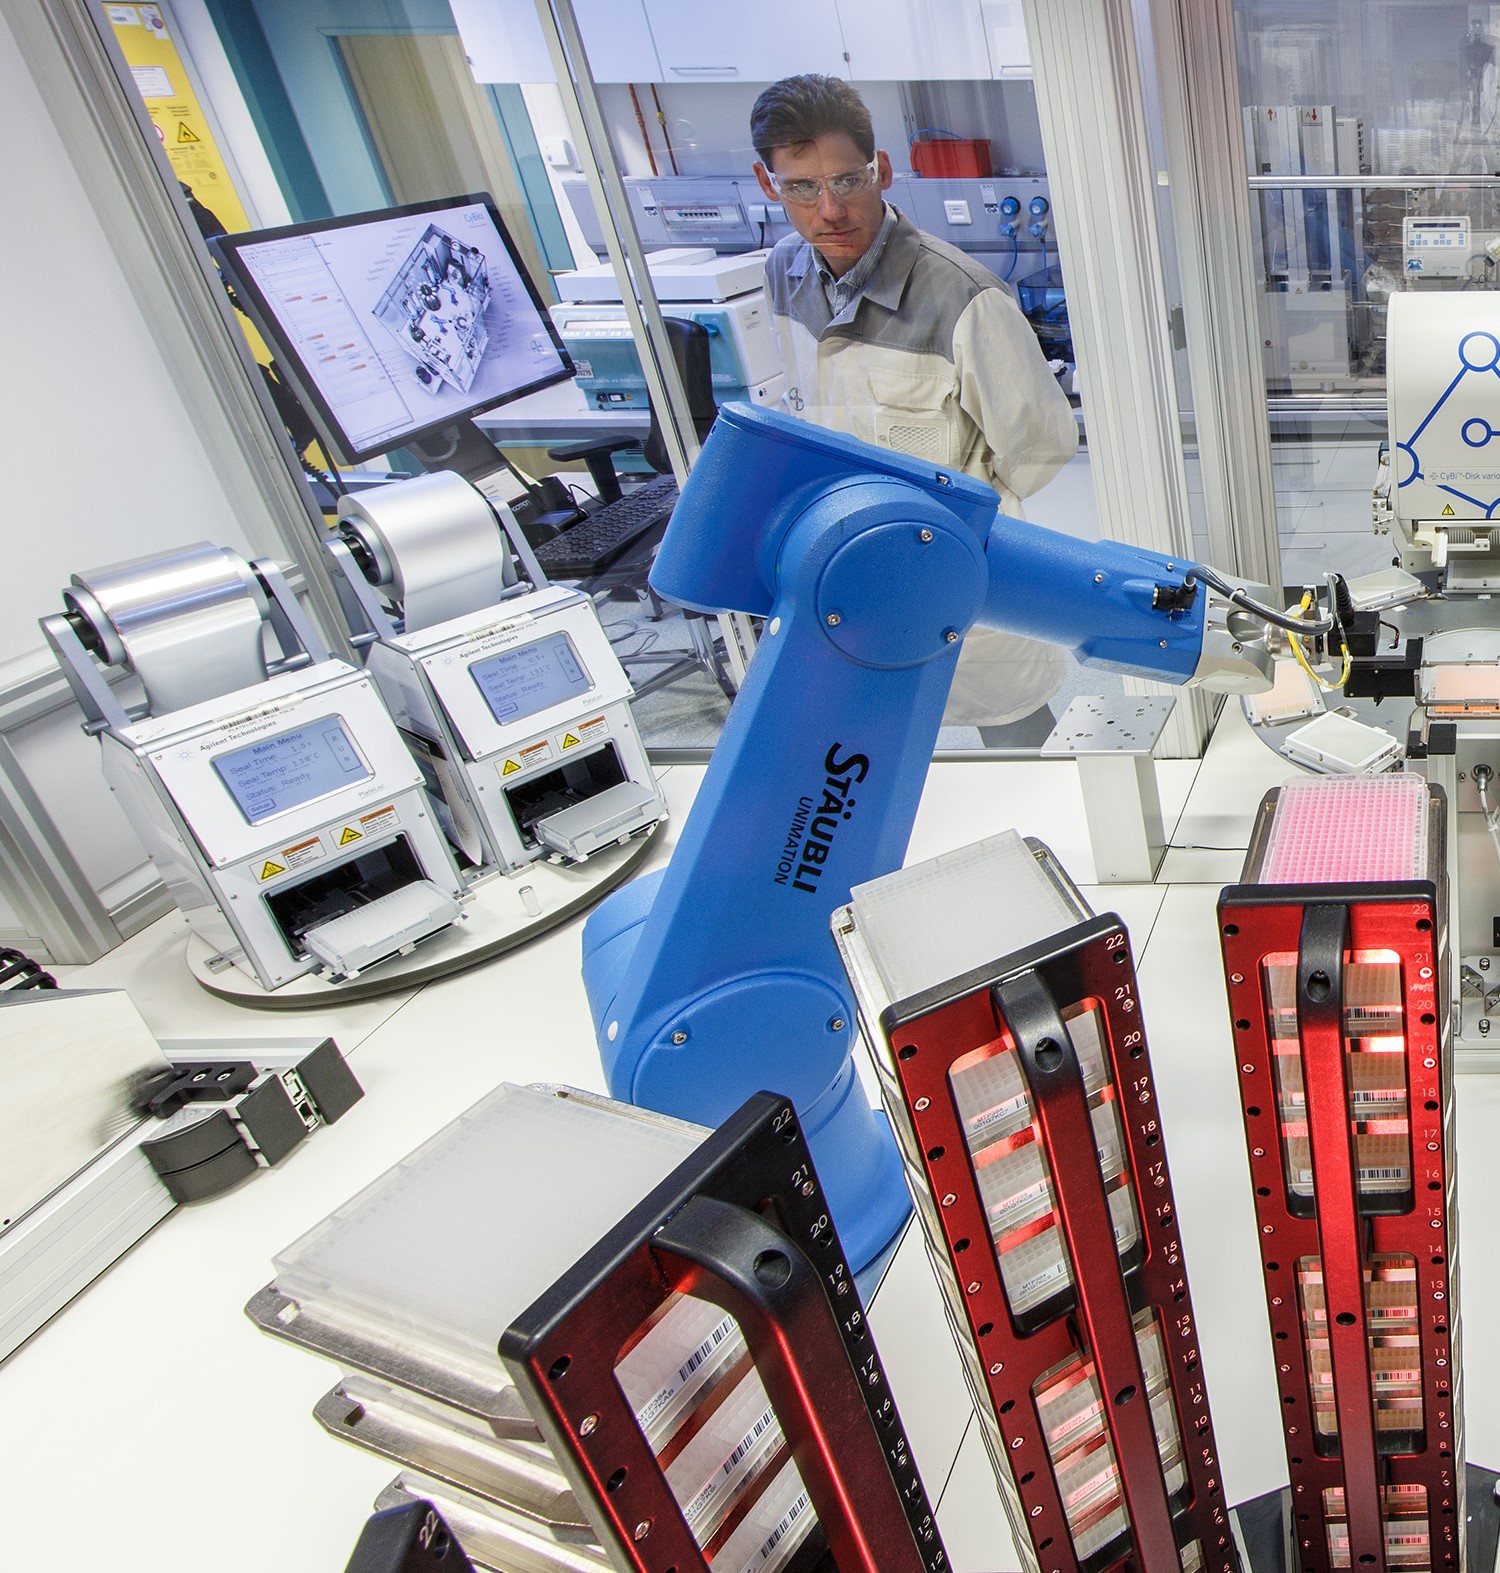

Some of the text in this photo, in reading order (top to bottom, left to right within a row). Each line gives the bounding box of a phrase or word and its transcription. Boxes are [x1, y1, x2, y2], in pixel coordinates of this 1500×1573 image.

[460, 635, 518, 659] Agilent Technologies
[499, 647, 538, 664] Main Menu
[482, 671, 499, 681] Seal
[488, 682, 505, 692] Seal
[522, 681, 544, 693] Ready
[200, 721, 278, 752] Agilent Technologies
[253, 733, 303, 755] Main Menu
[230, 762, 252, 775] Seal
[238, 775, 260, 788] Seal
[281, 772, 311, 787] Ready
[358, 784, 384, 797] PlateLoc
[251, 802, 271, 813] Setup
[792, 741, 870, 894] STÄUBLI
[774, 796, 814, 886] UNIMATION
[1412, 904, 1430, 915] 22
[1106, 934, 1125, 950] 22
[1414, 952, 1430, 963] 21
[1114, 983, 1131, 1000] 21
[1416, 1000, 1433, 1010] 20
[1123, 1031, 1141, 1047] 20
[1420, 1044, 1435, 1055] 19
[1133, 1076, 1148, 1091] 19
[1421, 1087, 1436, 1098] 18
[772, 1108, 792, 1133] 22
[1141, 1121, 1157, 1135] 18
[1423, 1129, 1438, 1138] 17
[1148, 1161, 1163, 1177] 17
[1425, 1169, 1440, 1178] 16
[791, 1164, 809, 1188] 21
[1155, 1203, 1171, 1217] 16
[1427, 1207, 1441, 1217] 15
[810, 1215, 828, 1239] 20
[1163, 1240, 1178, 1255] 15
[1428, 1244, 1443, 1254] 14
[828, 1263, 844, 1286] 19
[1169, 1279, 1184, 1293] 14
[1430, 1280, 1444, 1289] 13
[844, 1311, 861, 1332] 18
[1176, 1314, 1191, 1329] 13
[1431, 1315, 1446, 1324] 12
[1182, 1349, 1197, 1363] 12
[1434, 1348, 1446, 1357] 11
[860, 1354, 875, 1376] 17
[1189, 1383, 1202, 1395] 11
[1434, 1380, 1448, 1389] 10
[876, 1399, 891, 1419] 16
[1438, 1411, 1446, 1420] 9
[1194, 1415, 1208, 1428] 10
[890, 1438, 905, 1459] 15
[1439, 1441, 1447, 1450] 8
[1202, 1448, 1210, 1458] 9
[1441, 1470, 1448, 1479] 7
[904, 1478, 918, 1498] 14
[1207, 1478, 1216, 1488] 8
[1442, 1498, 1450, 1507] 6
[1212, 1507, 1219, 1518] 7
[419, 1509, 440, 1550] 22
[917, 1515, 931, 1535] 13
[1218, 1536, 1225, 1545] 6
[930, 1550, 944, 1571] 12
[1223, 1562, 1230, 1572] 5
